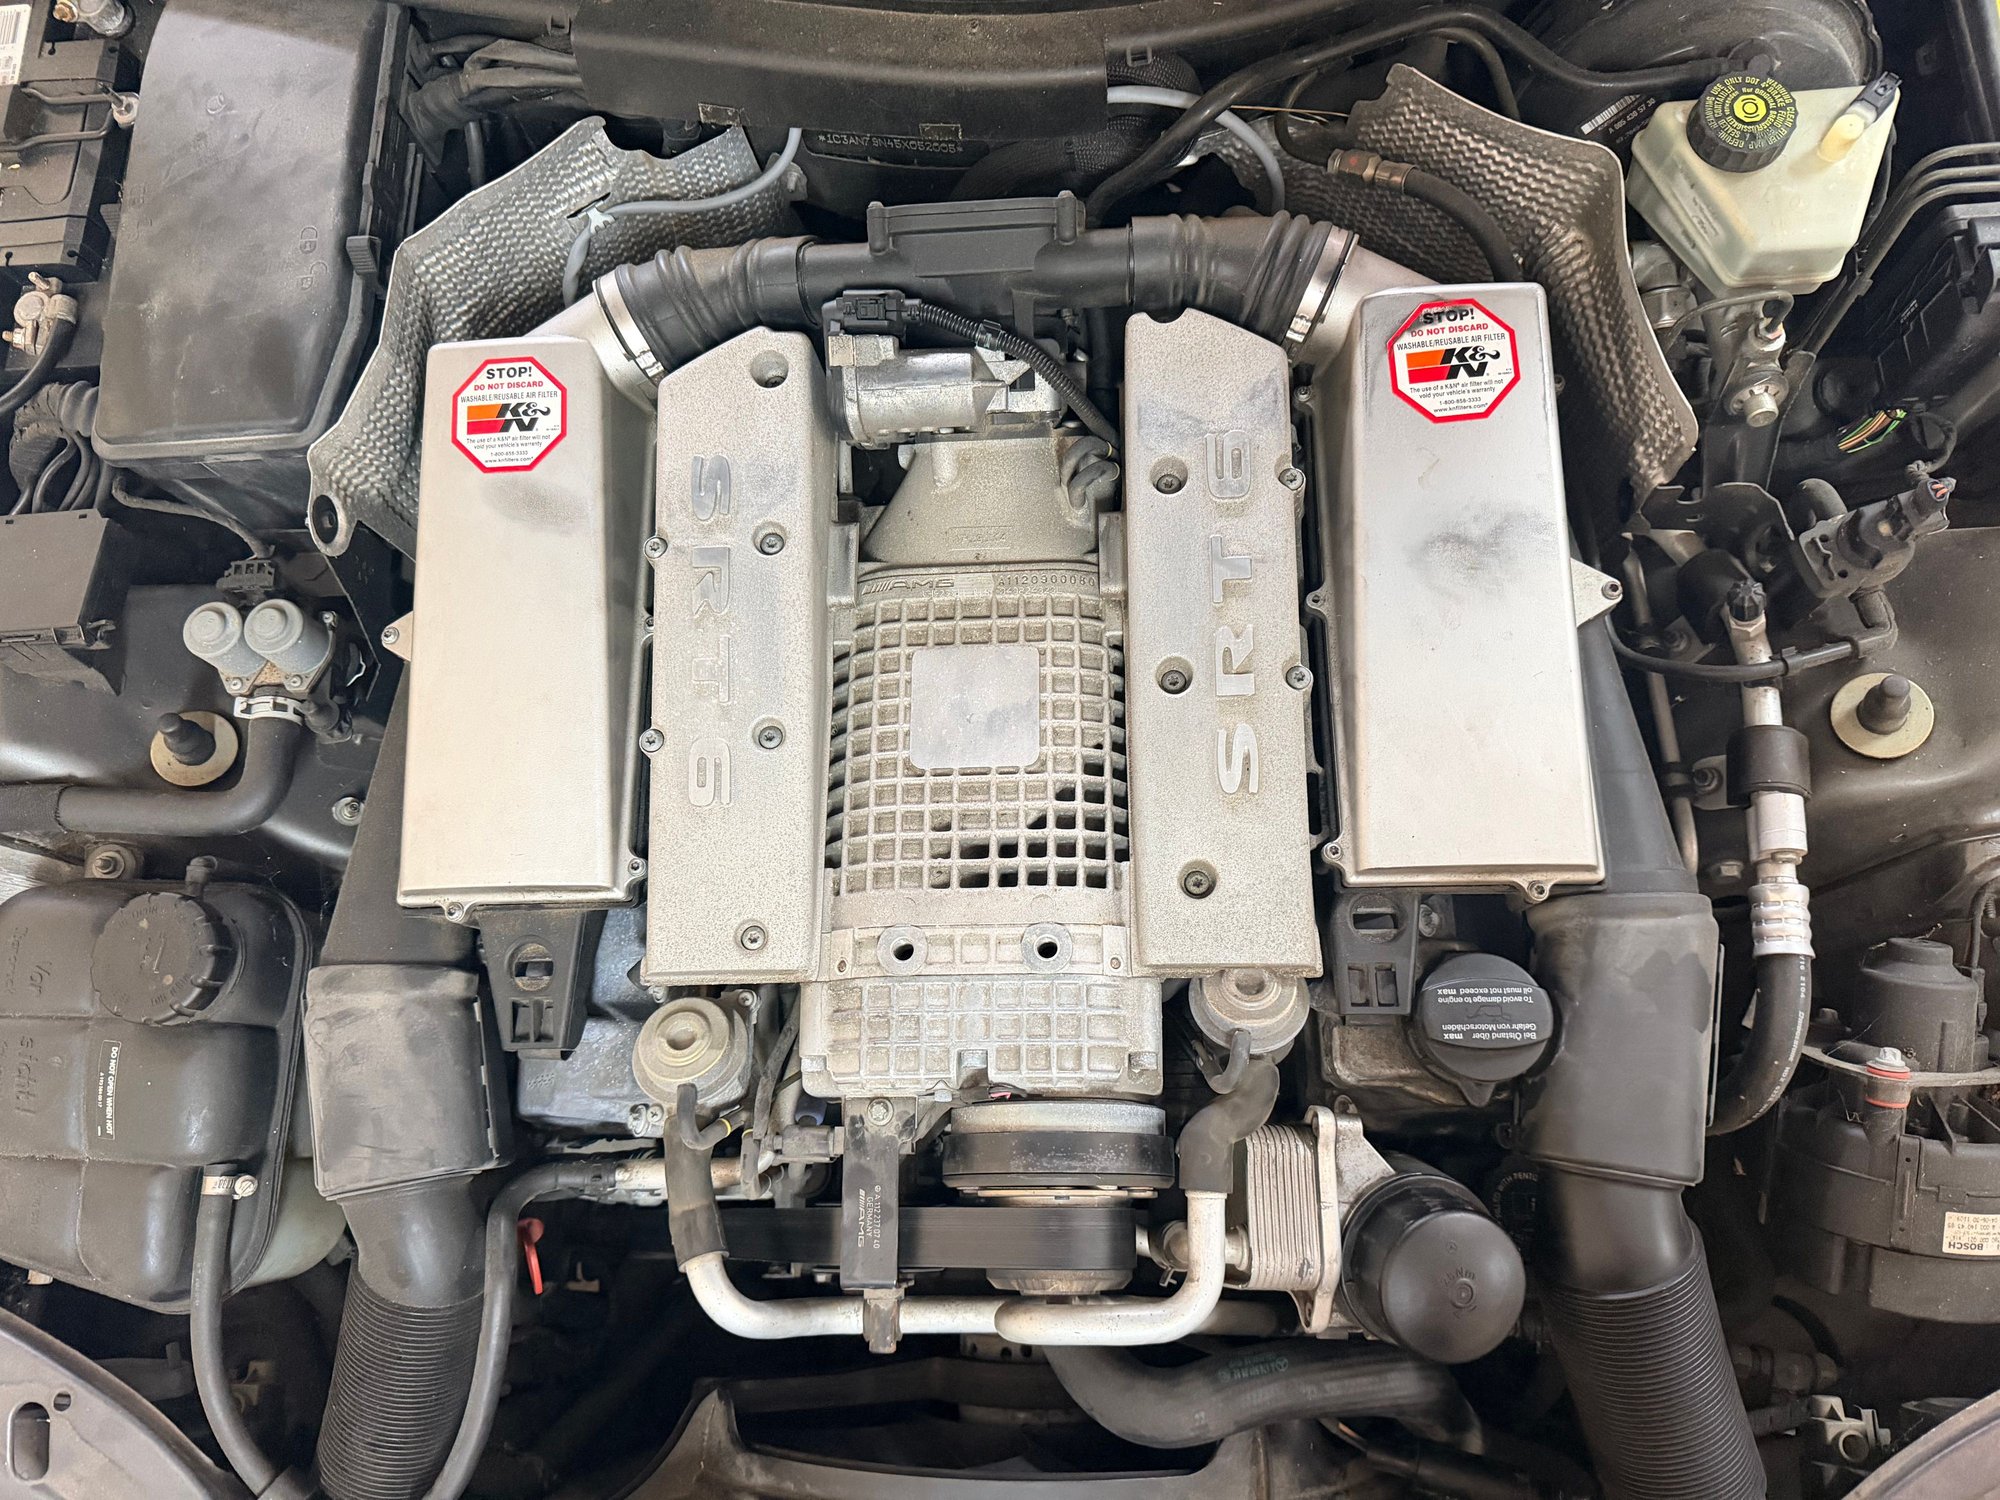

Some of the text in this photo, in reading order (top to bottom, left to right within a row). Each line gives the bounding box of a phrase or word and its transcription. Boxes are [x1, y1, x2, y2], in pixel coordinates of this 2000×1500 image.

[1724, 76, 1742, 86] ONLY
[1745, 76, 1760, 85] DOT
[1710, 83, 1724, 95] USE
[1766, 78, 1793, 104] WARNING
[1767, 86, 1786, 107] BRAKE
[1773, 110, 1787, 128] FLUID
[1784, 107, 1795, 128] CLEAN
[1718, 119, 1741, 138] SEALED
[1422, 307, 1475, 325] STOP!
[1411, 323, 1489, 338] DO NOT DISCARD
[1396, 332, 1506, 351] WASHABLE/REUSABLE AIR FILTER
[486, 366, 532, 380] STOP!
[507, 381, 544, 389] DISCARD
[460, 390, 558, 403] WASHABLE/REUSABLE AIR FILTER
[1460, 987, 1489, 995] exceed
[1438, 996, 1463, 1004] engine
[1523, 996, 1534, 1004] To
[1442, 1023, 1496, 1031] Motorschäden
[1511, 1023, 1537, 1031] Gefahr
[105, 1046, 119, 1135] DO NOT OPEN WHEN HOT
[866, 1197, 874, 1237] GERMANY
[873, 1229, 880, 1238] 07
[873, 1239, 880, 1249] 40
[1948, 1241, 1984, 1251] BOSCH
